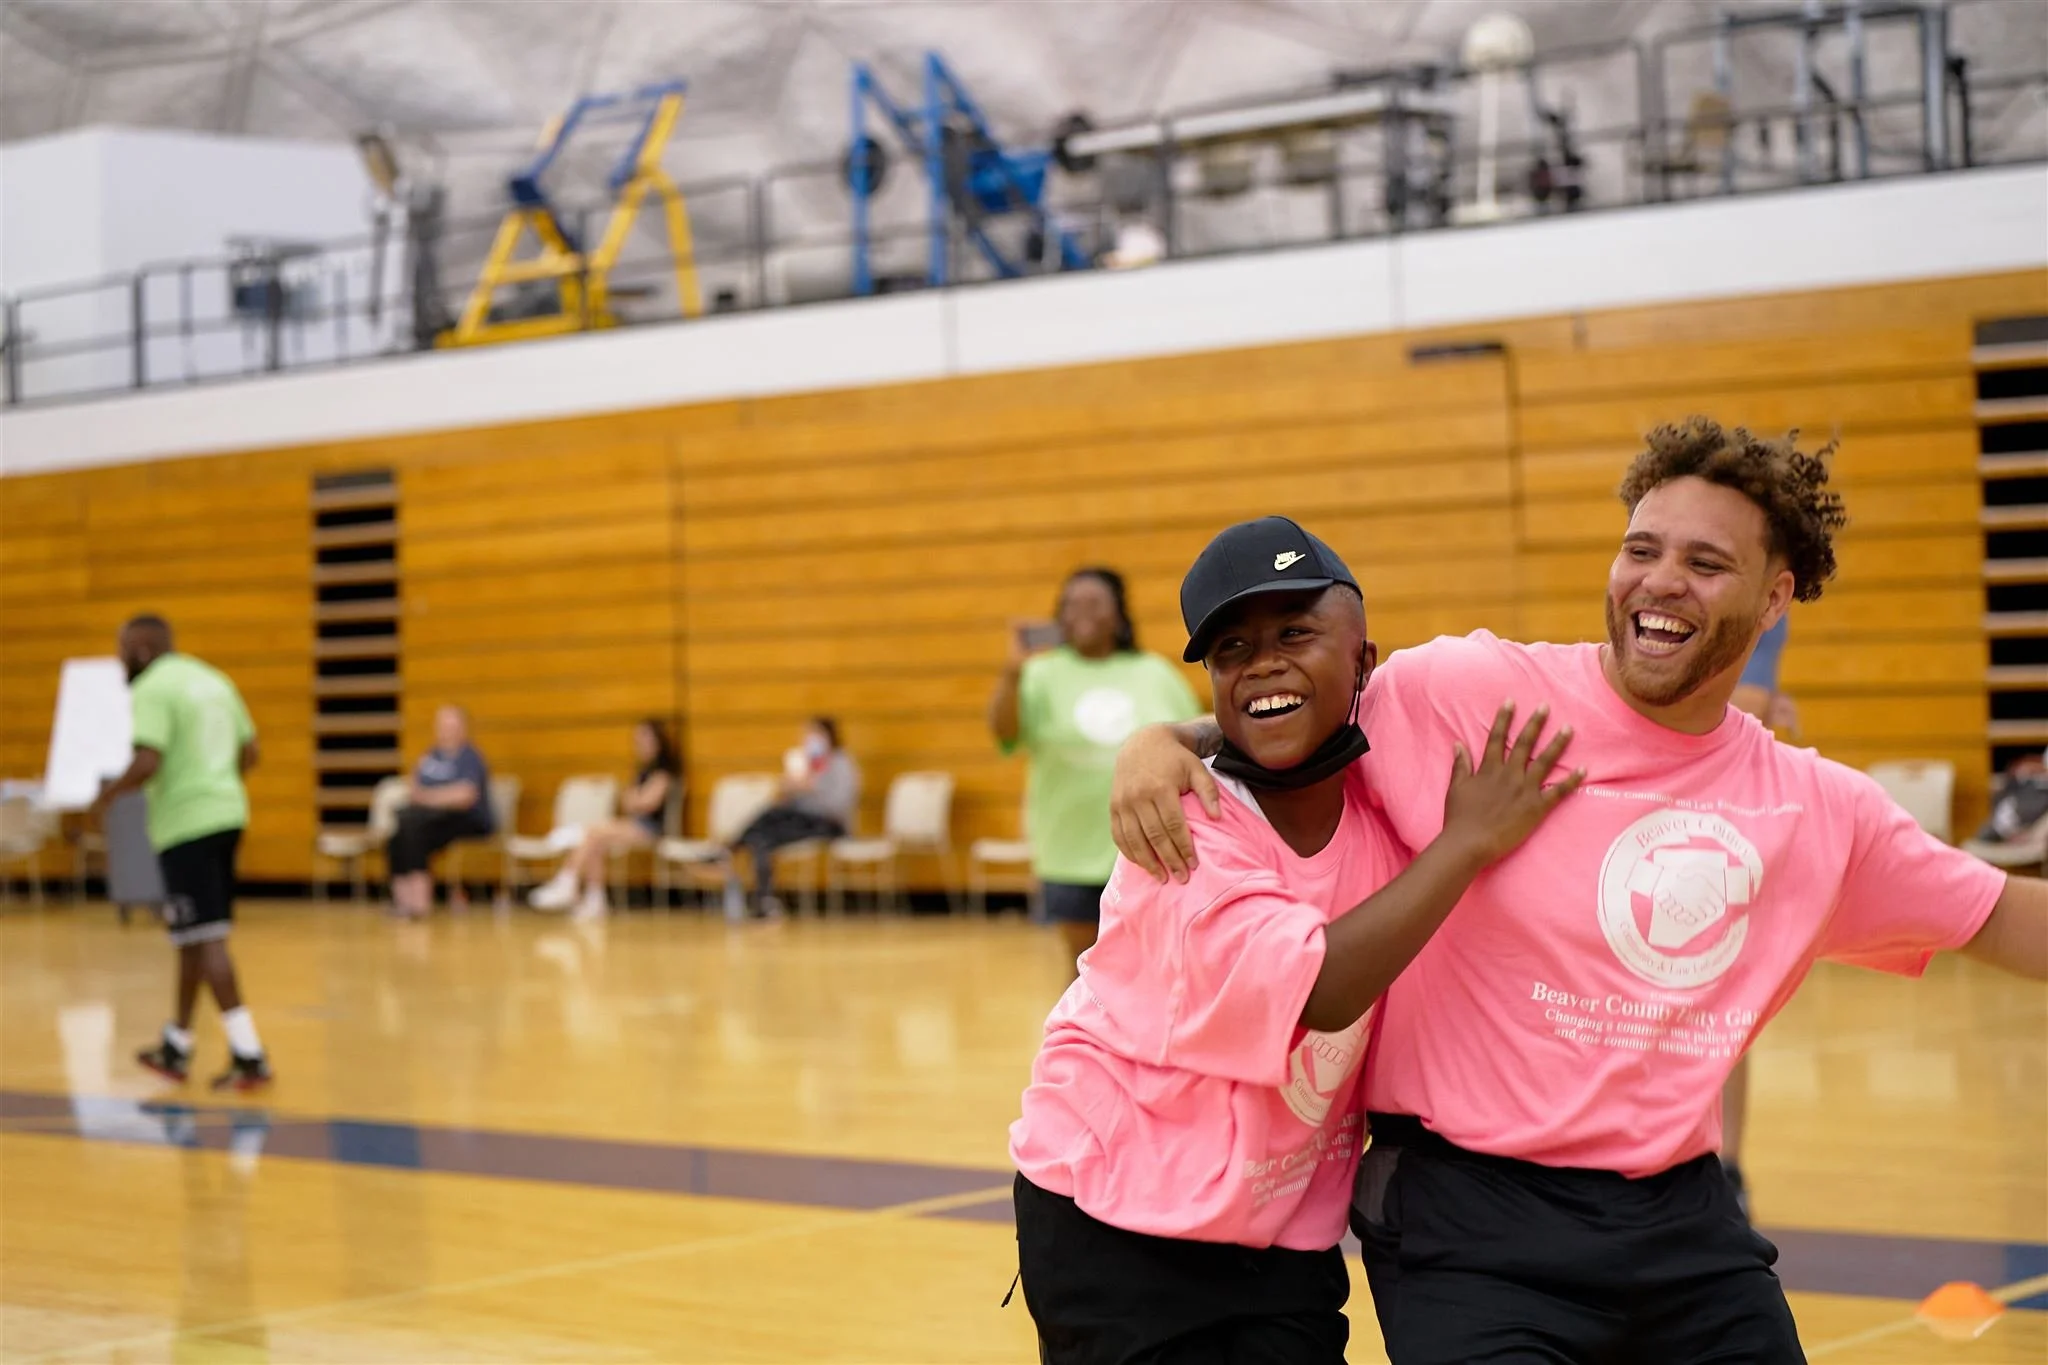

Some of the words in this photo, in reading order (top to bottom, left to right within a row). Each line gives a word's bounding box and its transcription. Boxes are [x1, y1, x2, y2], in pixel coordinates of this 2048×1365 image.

[1276, 551, 1297, 563] NIKE
[1635, 817, 1690, 850] Beaver
[1530, 981, 1600, 1014] Beaver
[1544, 1008, 1604, 1033] Changing
[1554, 1027, 1577, 1040] and
